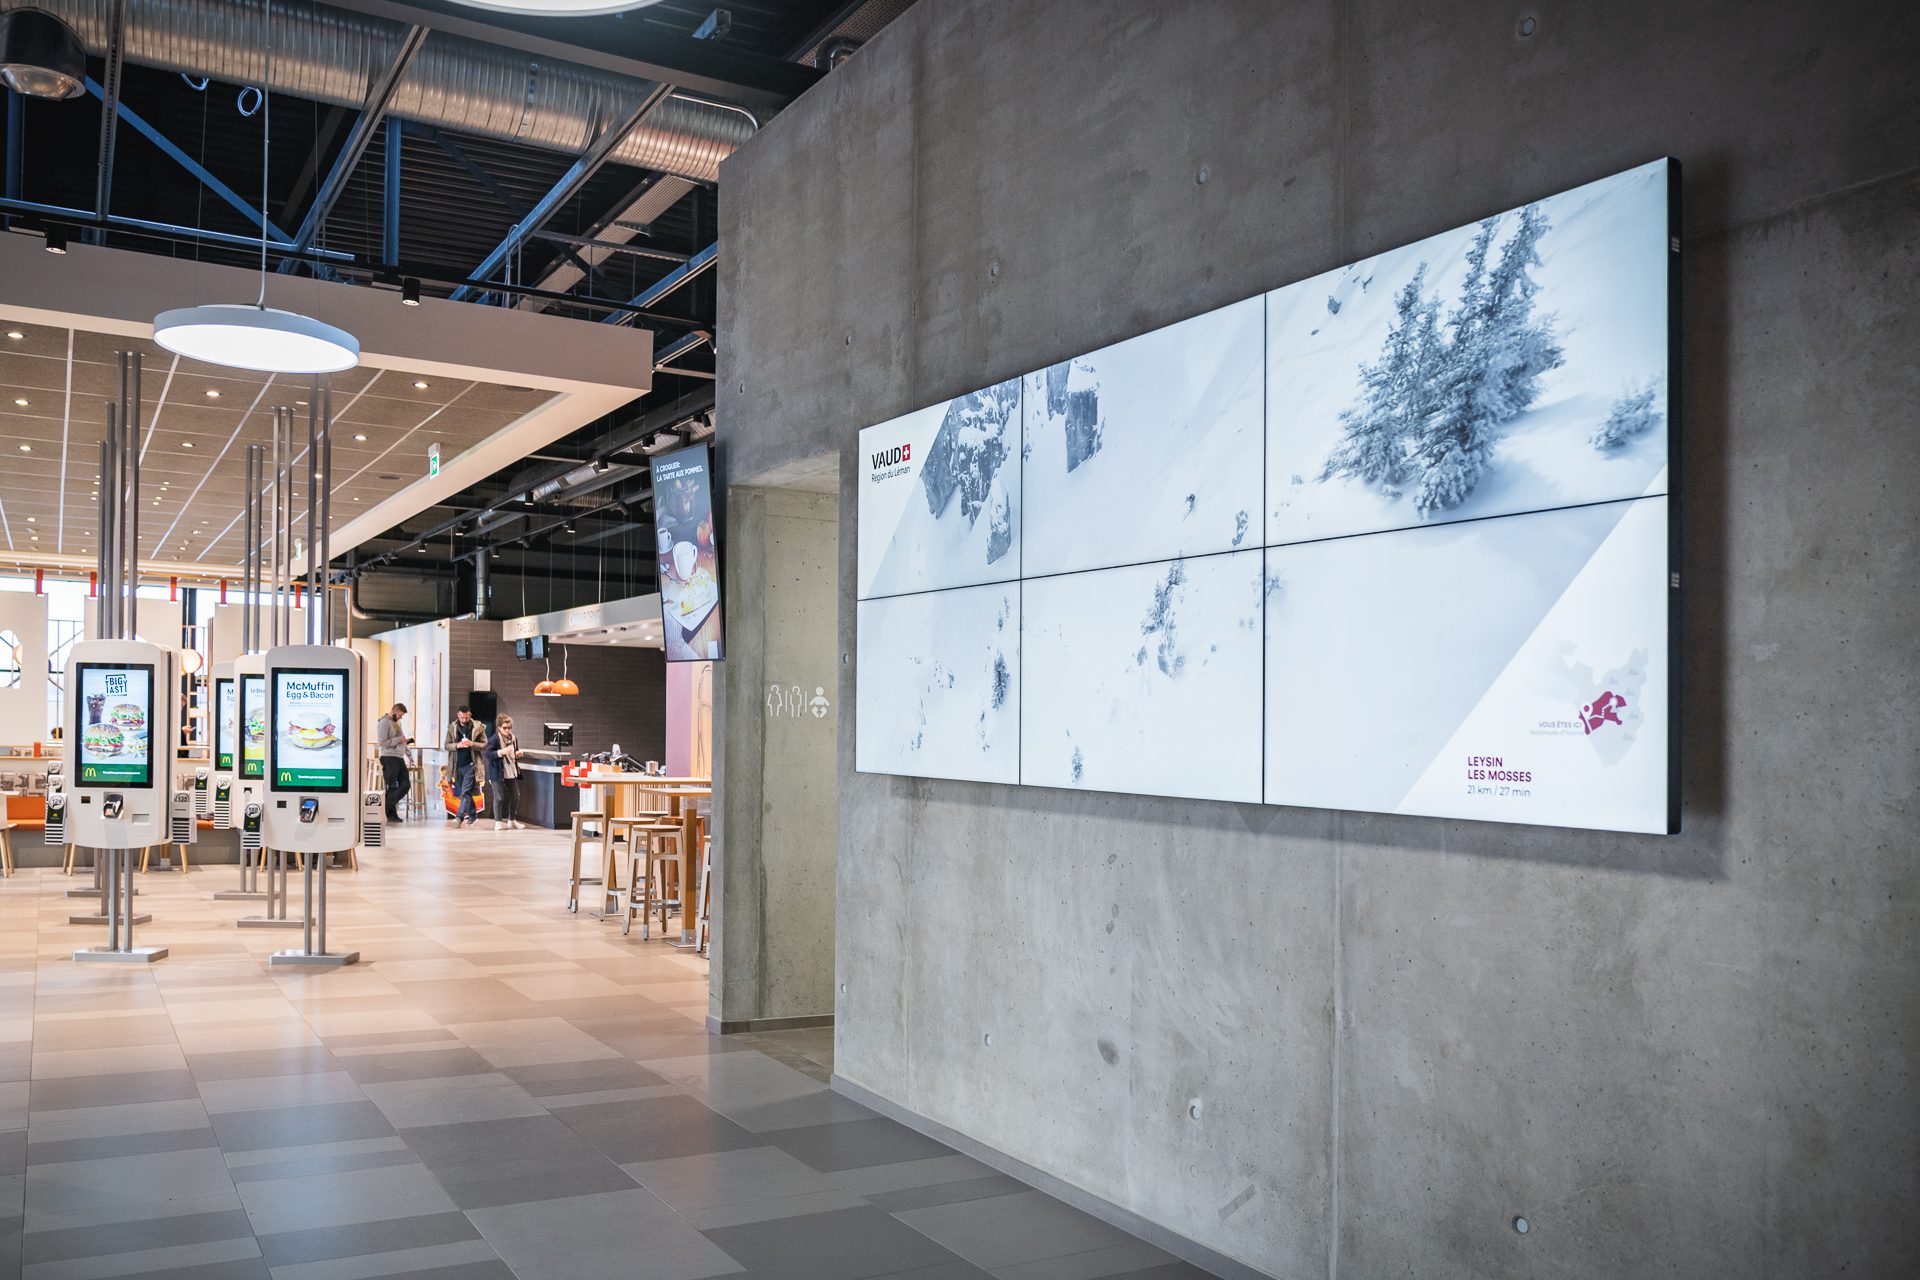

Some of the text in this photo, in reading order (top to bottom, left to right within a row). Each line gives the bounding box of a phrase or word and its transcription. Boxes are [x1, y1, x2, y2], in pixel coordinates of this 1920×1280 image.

[872, 447, 901, 469] VAUD
[662, 471, 675, 481] TARTE
[675, 469, 684, 478] AUX
[887, 469, 893, 478] du
[894, 466, 911, 476] Léman
[109, 677, 123, 686] BIG
[286, 682, 334, 691] McMuffin
[286, 691, 334, 700] Egg & Bacon
[1467, 756, 1503, 767] LEYSIN
[1467, 769, 1532, 782] LES MOSSES
[1467, 785, 1476, 794] 21
[1478, 785, 1492, 795] km
[1499, 786, 1510, 796] 27
[1512, 787, 1531, 797] min
